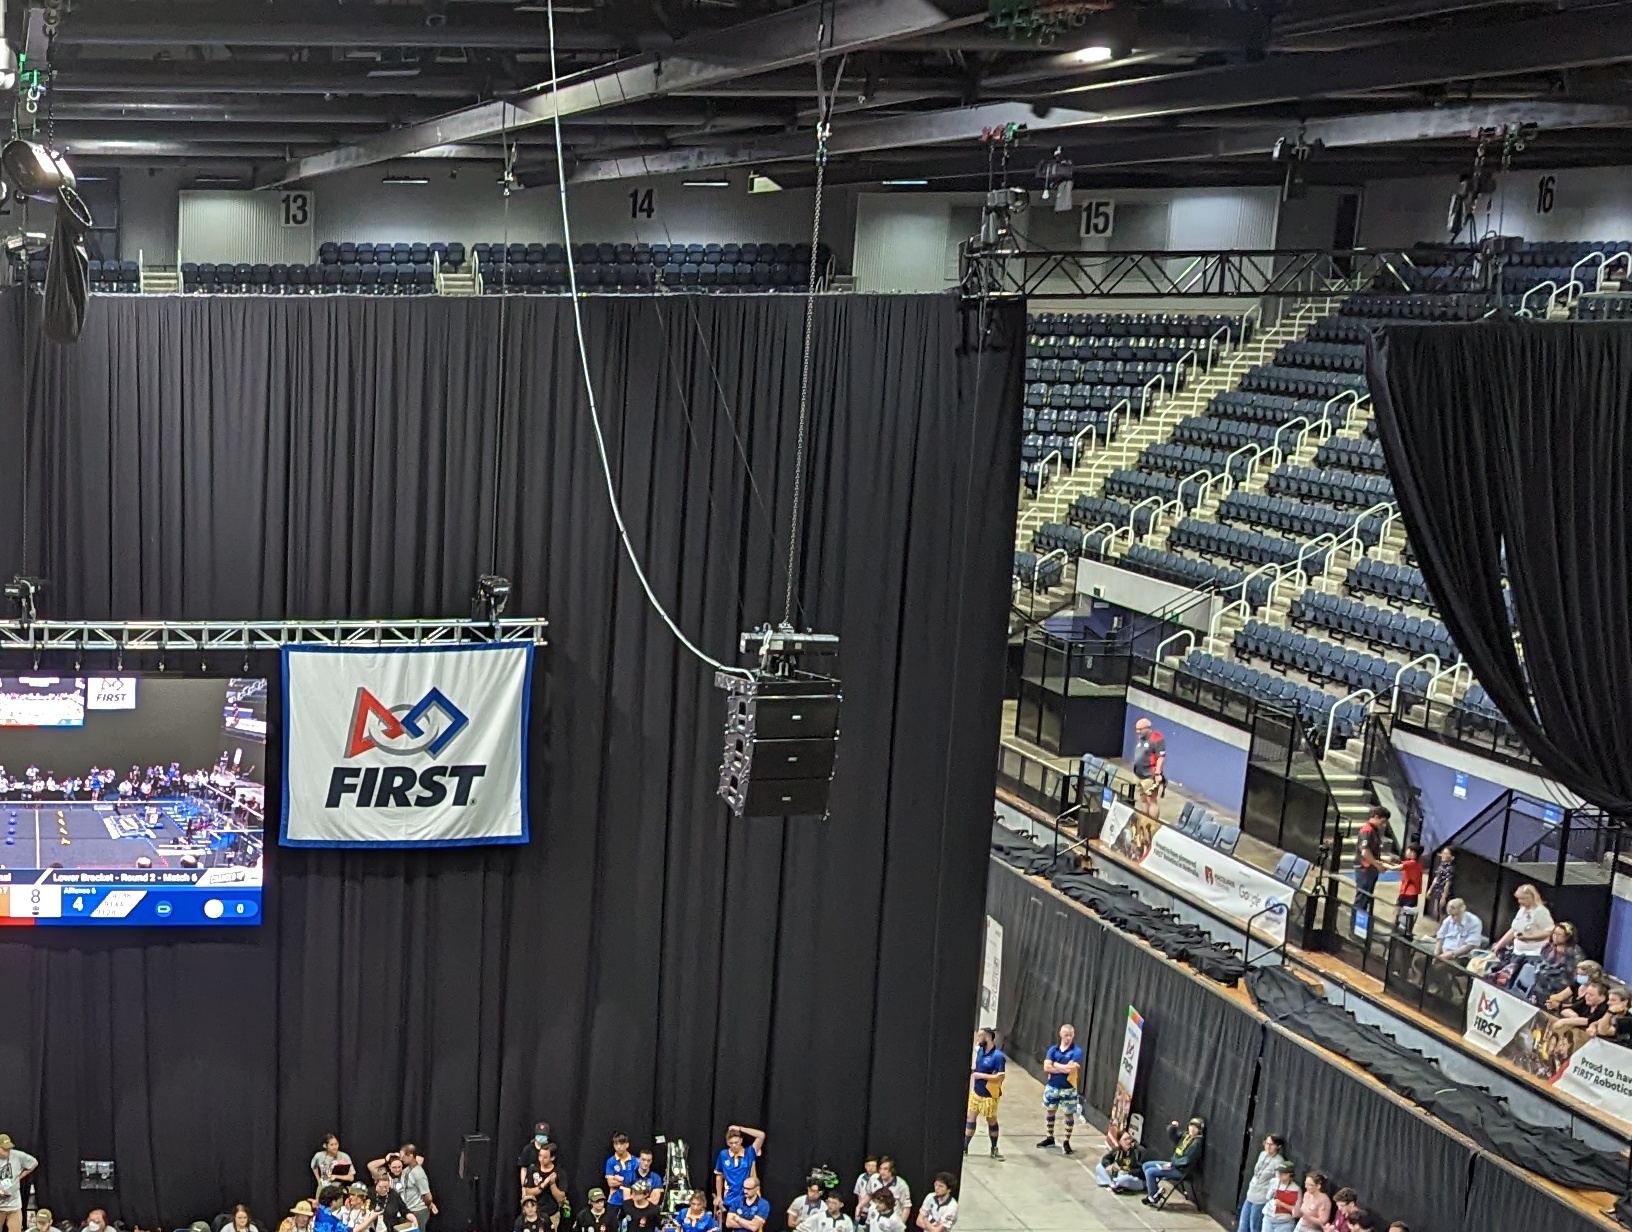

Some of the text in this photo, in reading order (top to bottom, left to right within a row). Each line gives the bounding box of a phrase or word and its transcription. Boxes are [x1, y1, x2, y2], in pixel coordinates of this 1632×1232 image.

[629, 188, 655, 220] 14
[1537, 175, 1556, 214] 16
[282, 194, 308, 225] 13
[1082, 200, 1111, 235] 15
[96, 693, 128, 702] FIRST
[325, 764, 487, 808] FIRST
[53, 873, 80, 882] Lower
[121, 873, 149, 882] Round
[150, 873, 156, 882] 2
[163, 873, 190, 882] Match
[31, 889, 41, 904] 8
[72, 896, 84, 912] 4
[236, 903, 245, 914] 0
[1473, 1016, 1503, 1039] FIRST
[1573, 1066, 1593, 1081] FIRST
[1581, 1057, 1632, 1084] Proud to hav
